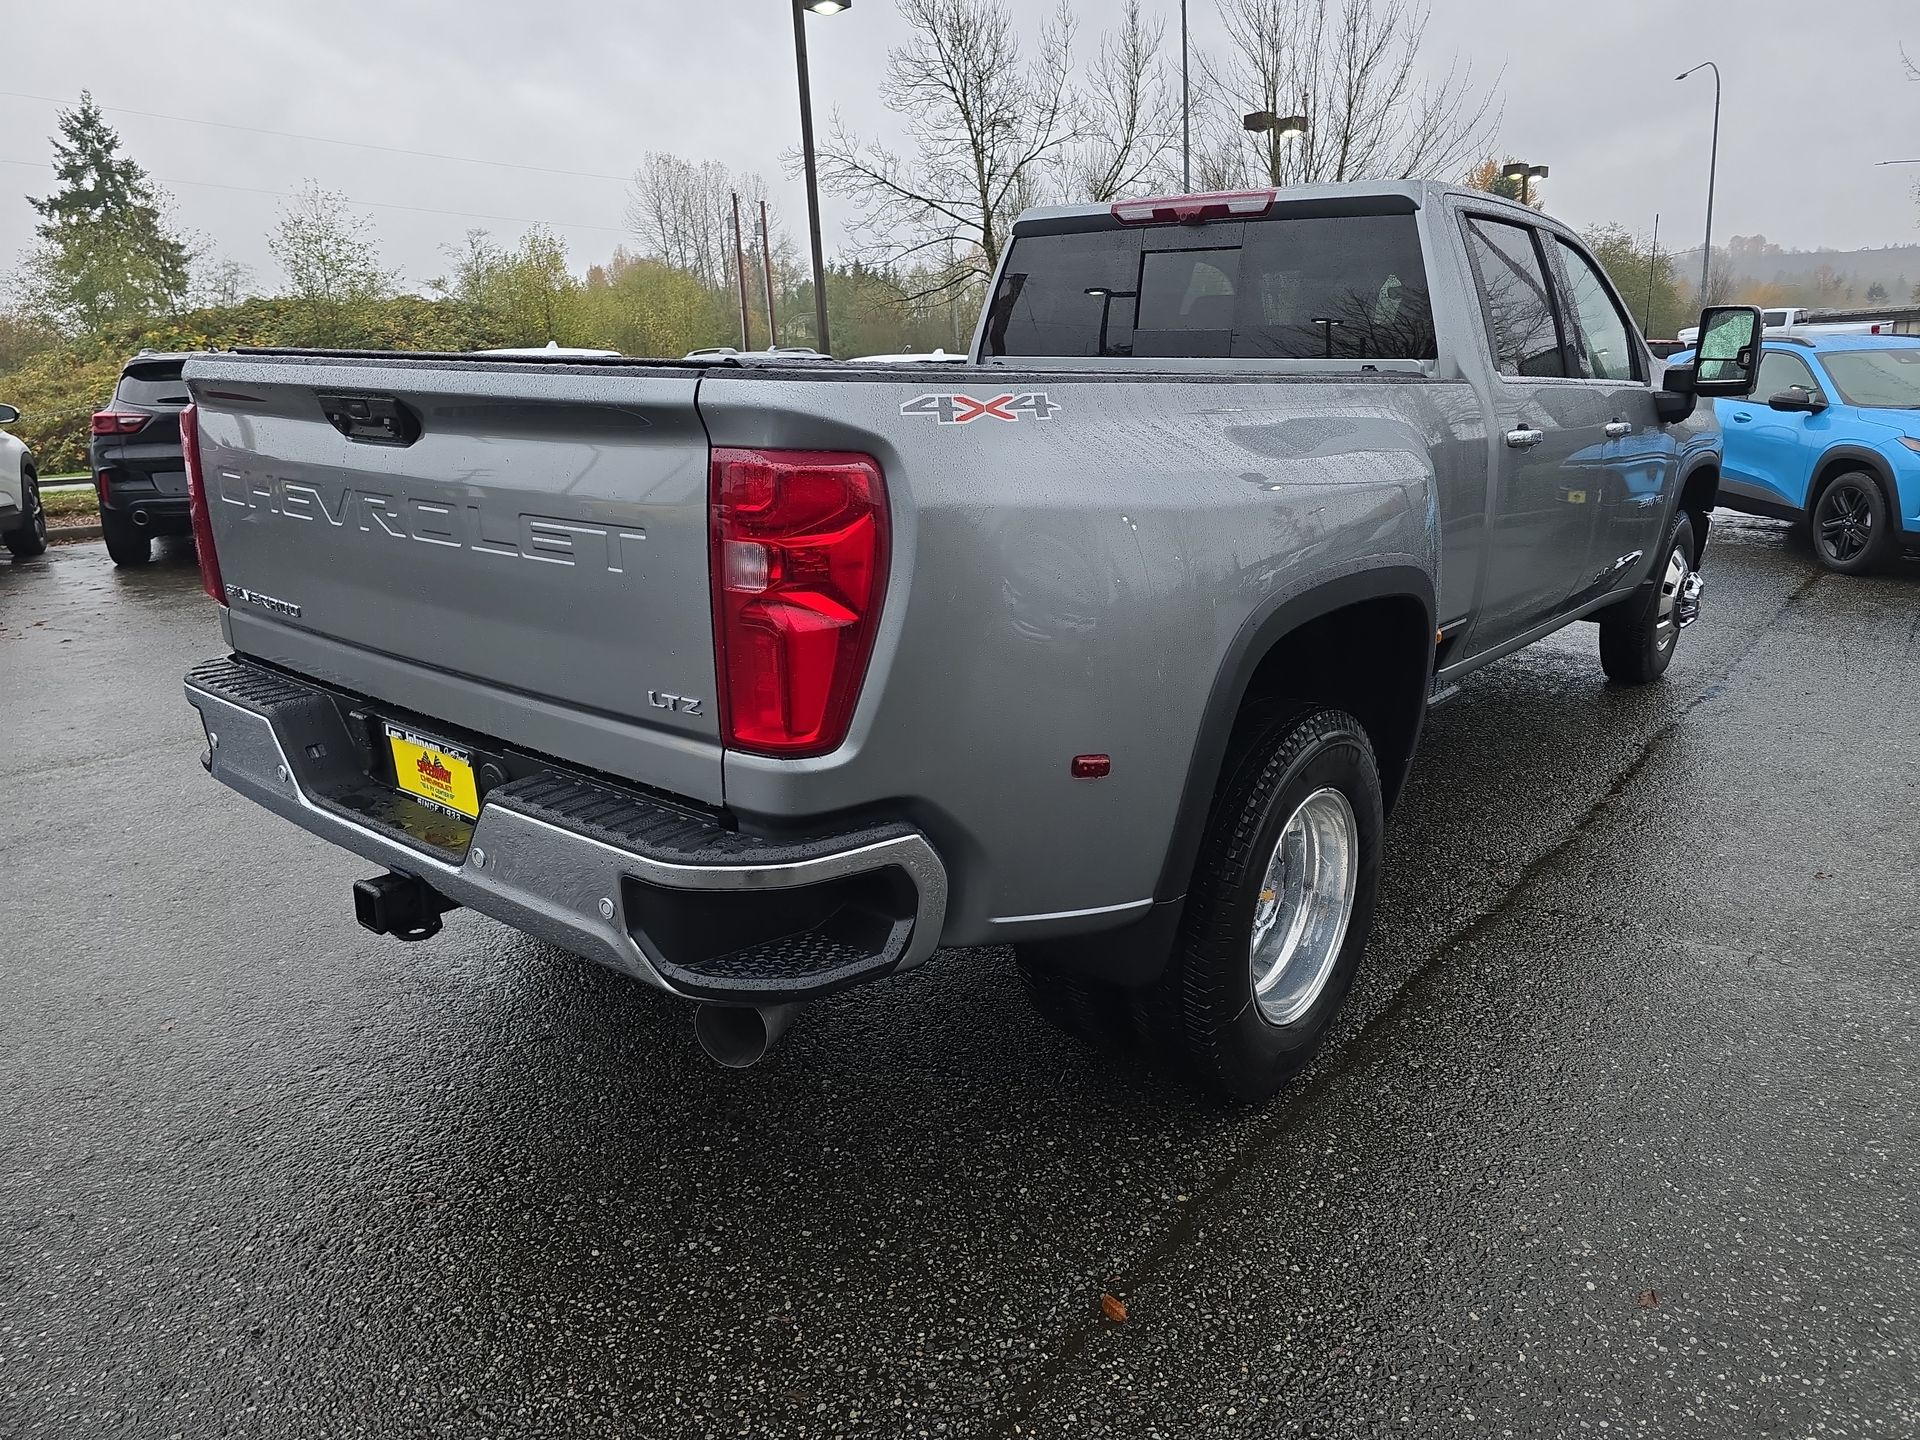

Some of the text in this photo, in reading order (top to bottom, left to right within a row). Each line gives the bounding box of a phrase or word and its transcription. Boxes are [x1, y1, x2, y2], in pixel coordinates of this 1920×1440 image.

[217, 465, 646, 573] CHEVROLET
[226, 583, 301, 617] SILVERADO
[647, 690, 703, 716] LTZ
[385, 724, 441, 753] Lee Johnson
[417, 797, 440, 812] SINCE
